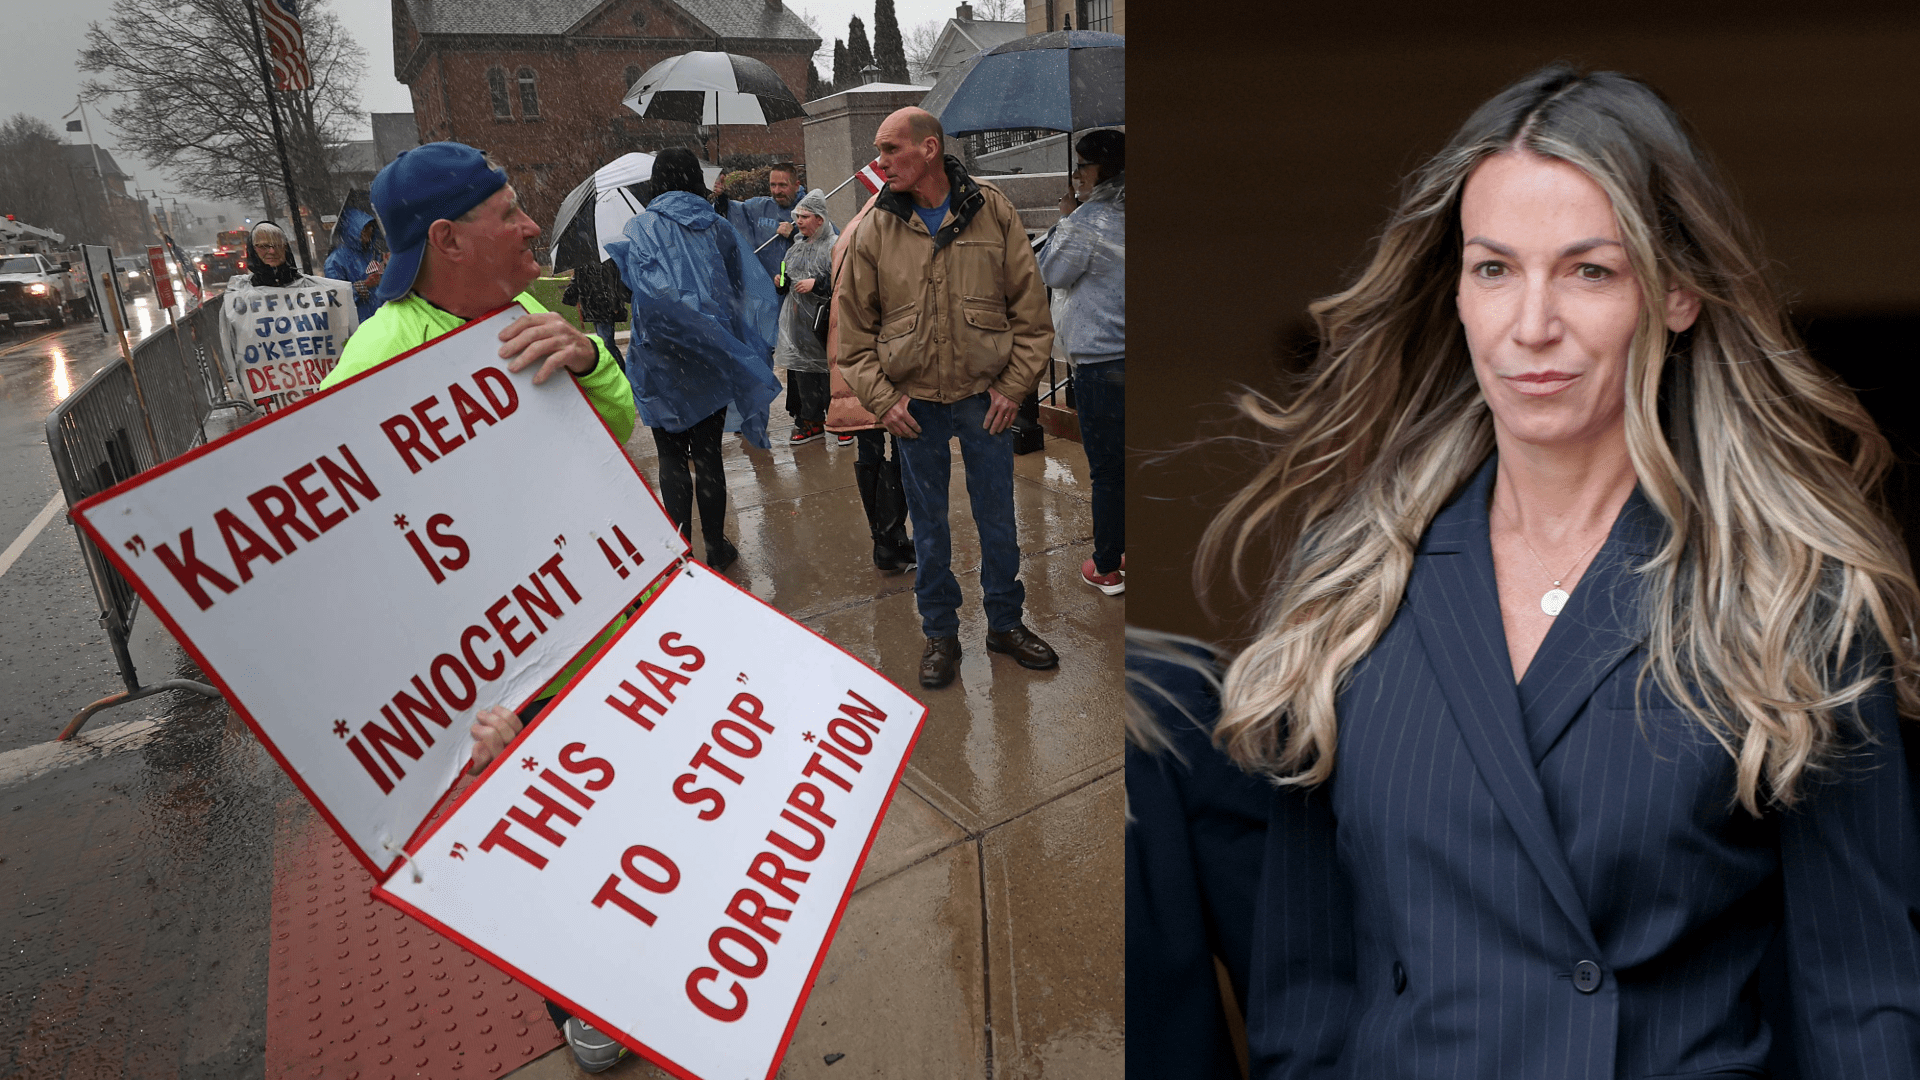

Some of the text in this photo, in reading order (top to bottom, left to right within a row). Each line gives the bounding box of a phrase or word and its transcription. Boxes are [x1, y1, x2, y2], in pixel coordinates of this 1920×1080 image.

[233, 289, 342, 315] OFFICER
[255, 312, 330, 338] JOHN
[244, 335, 336, 363] O'KEEFE
[380, 366, 519, 474] READ
[604, 632, 706, 732] HAS
[591, 844, 681, 928] TO
[686, 690, 888, 1023] CORRUPTION
